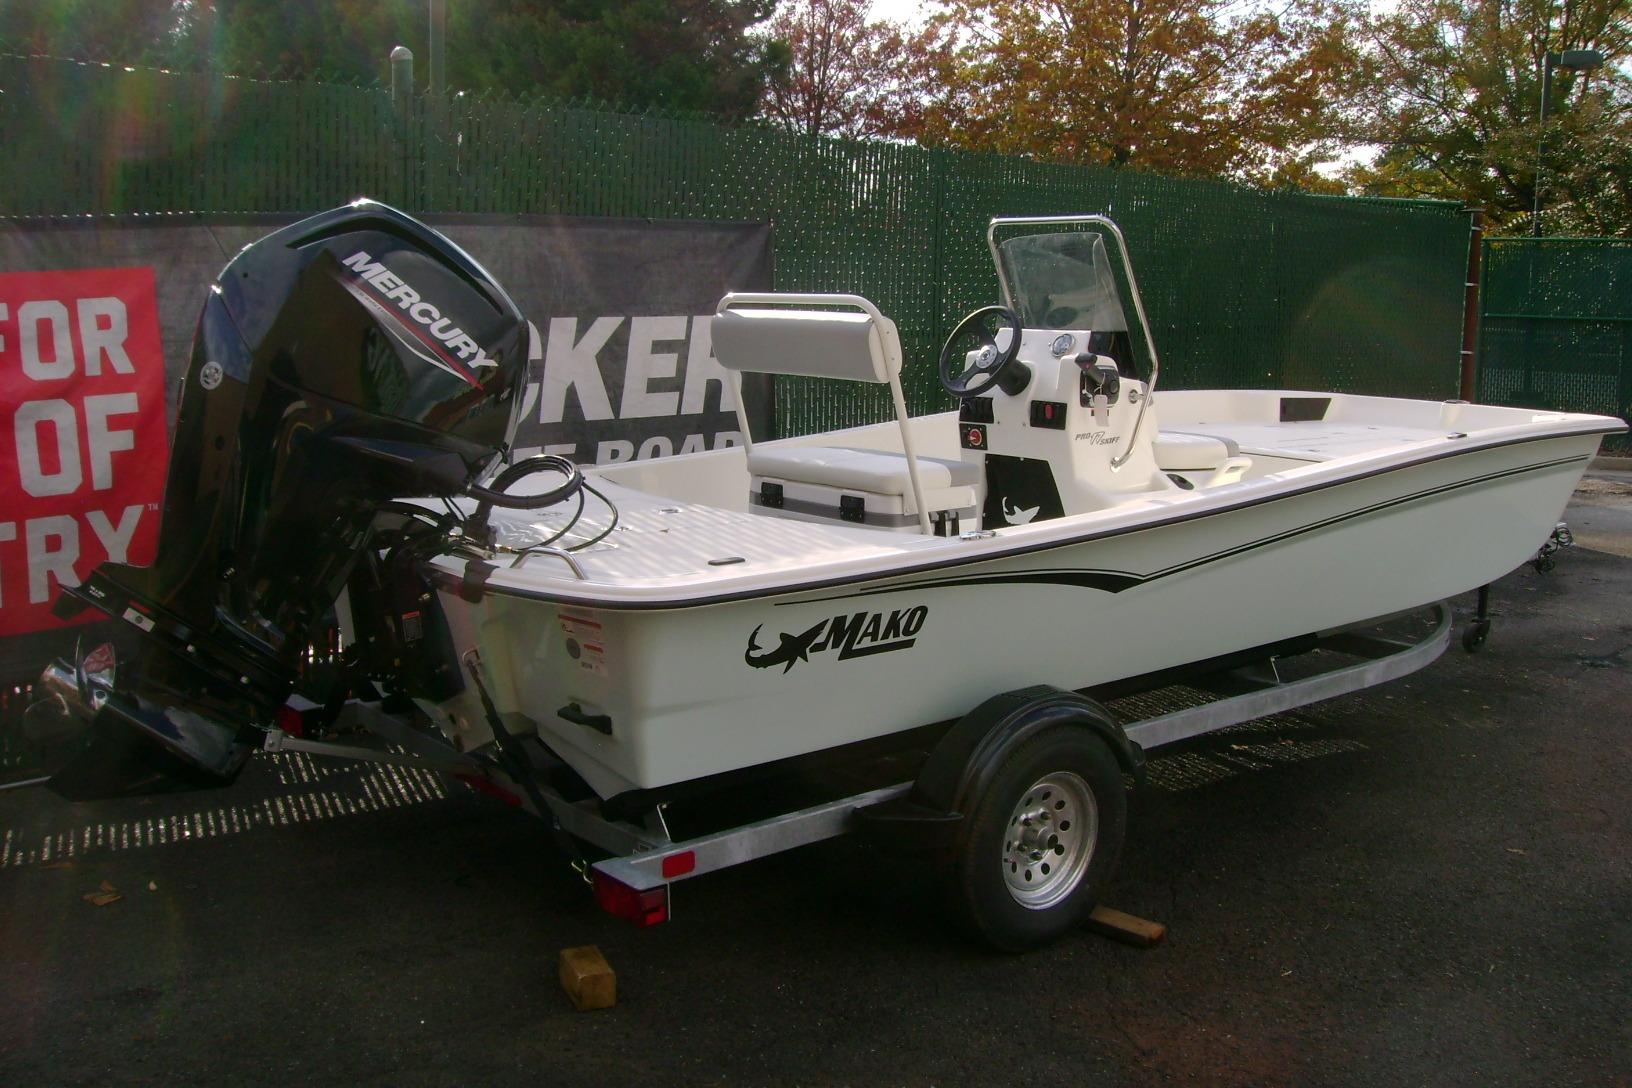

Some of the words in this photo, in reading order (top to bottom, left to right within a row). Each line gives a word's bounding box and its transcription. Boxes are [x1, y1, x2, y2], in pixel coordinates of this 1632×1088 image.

[0, 296, 136, 381] OR
[342, 251, 499, 369] MERCURY
[14, 392, 139, 498] OF
[809, 605, 928, 661] MAKO
